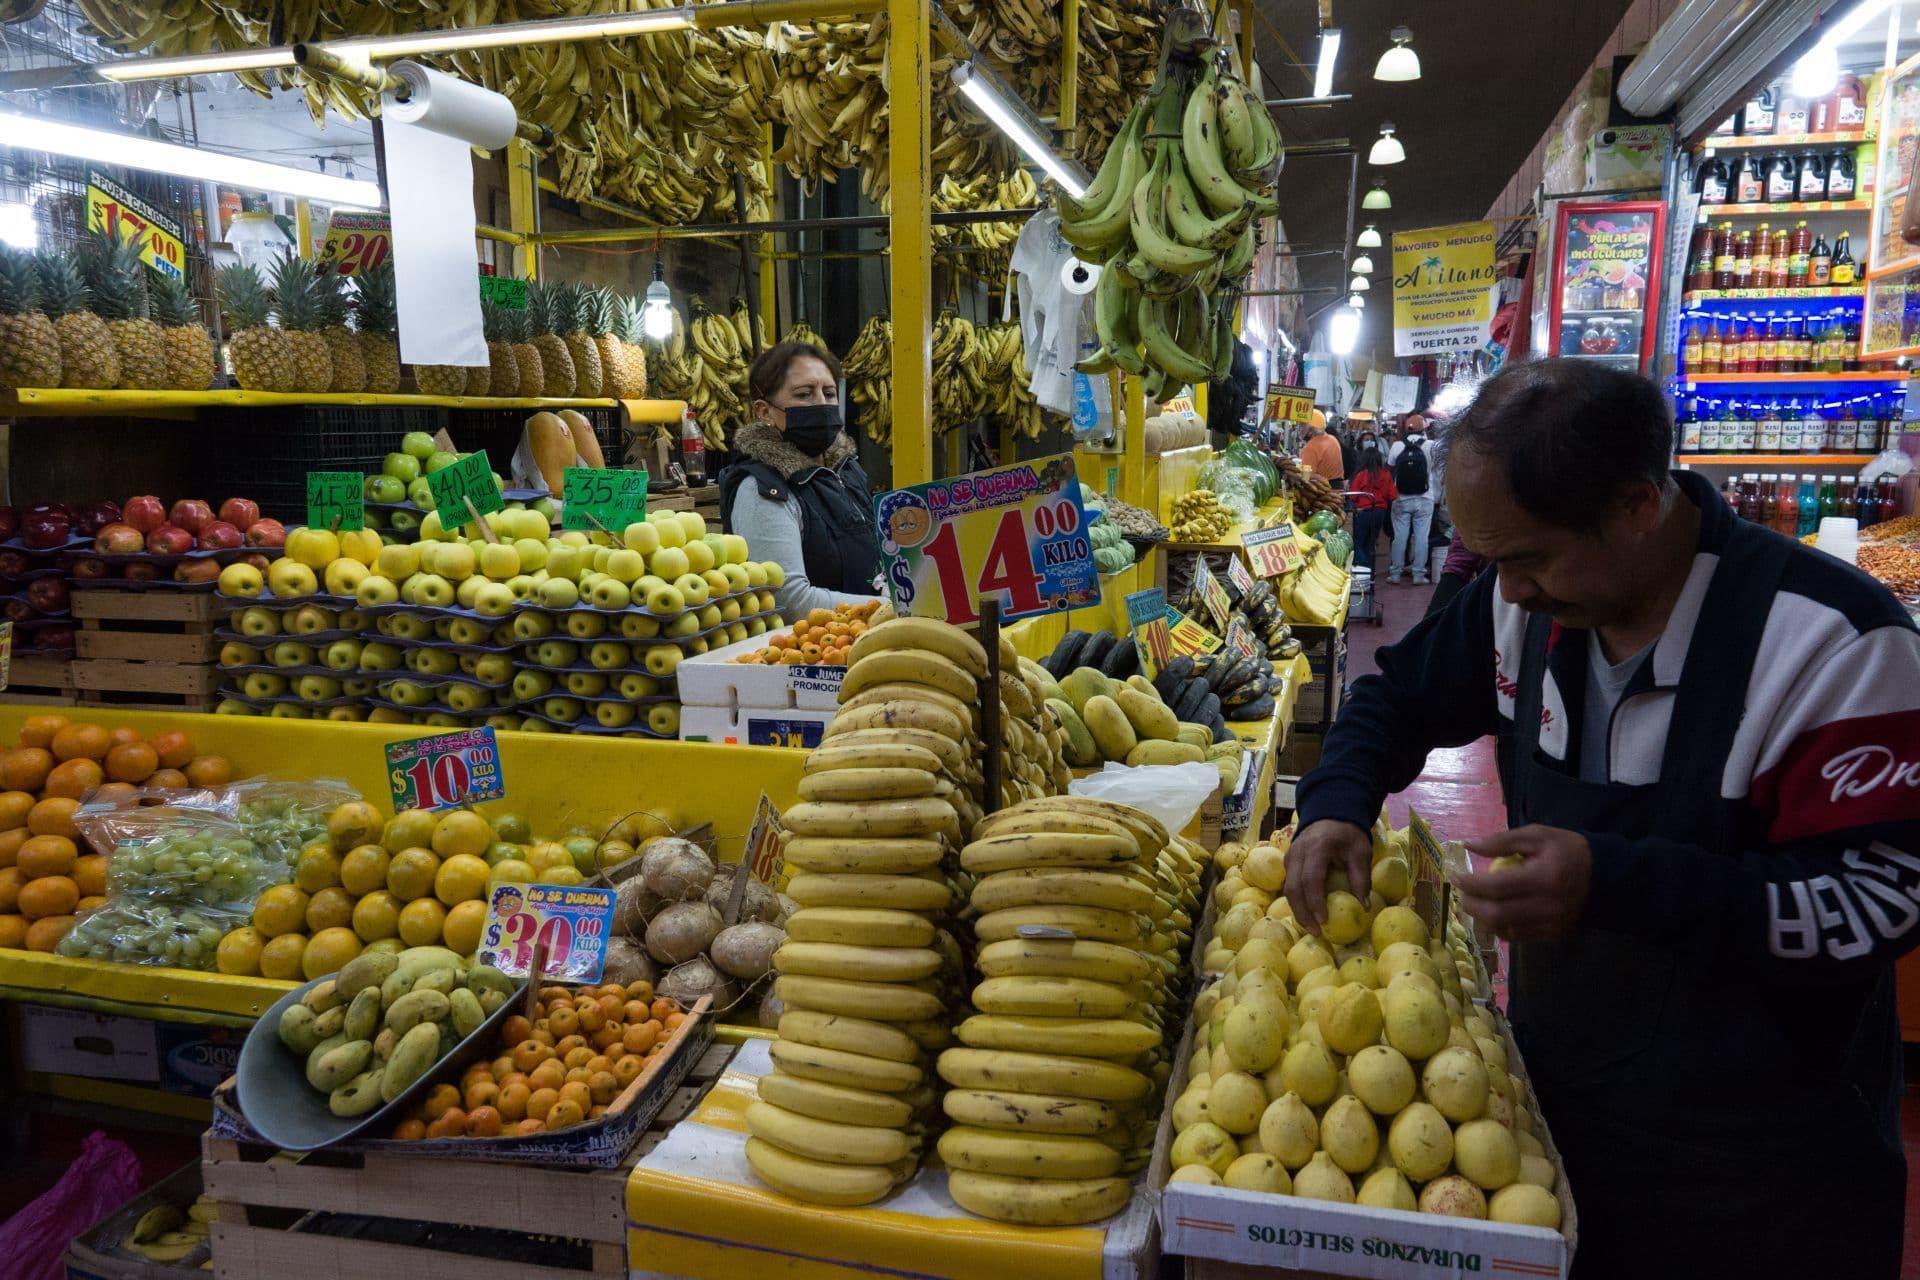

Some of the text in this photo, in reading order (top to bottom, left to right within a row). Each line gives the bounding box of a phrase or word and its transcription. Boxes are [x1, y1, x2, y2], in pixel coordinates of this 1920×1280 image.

[152, 233, 177, 263] 00
[1395, 234, 1493, 253] MAYOREO MENUDEO
[1413, 335, 1477, 349] PUERTA 26
[926, 465, 1039, 508] NO SE DUERMA
[1034, 499, 1079, 538] 00
[1045, 538, 1088, 566] KILO
[1282, 542, 1296, 558] 00
[470, 747, 493, 765] 00
[473, 763, 495, 777] KILO
[528, 887, 611, 906] NO SE DUERMA
[575, 917, 602, 937] 00
[576, 938, 600, 951] KILO
[1248, 1223, 1481, 1271] DURAZNOS SELECTOS
